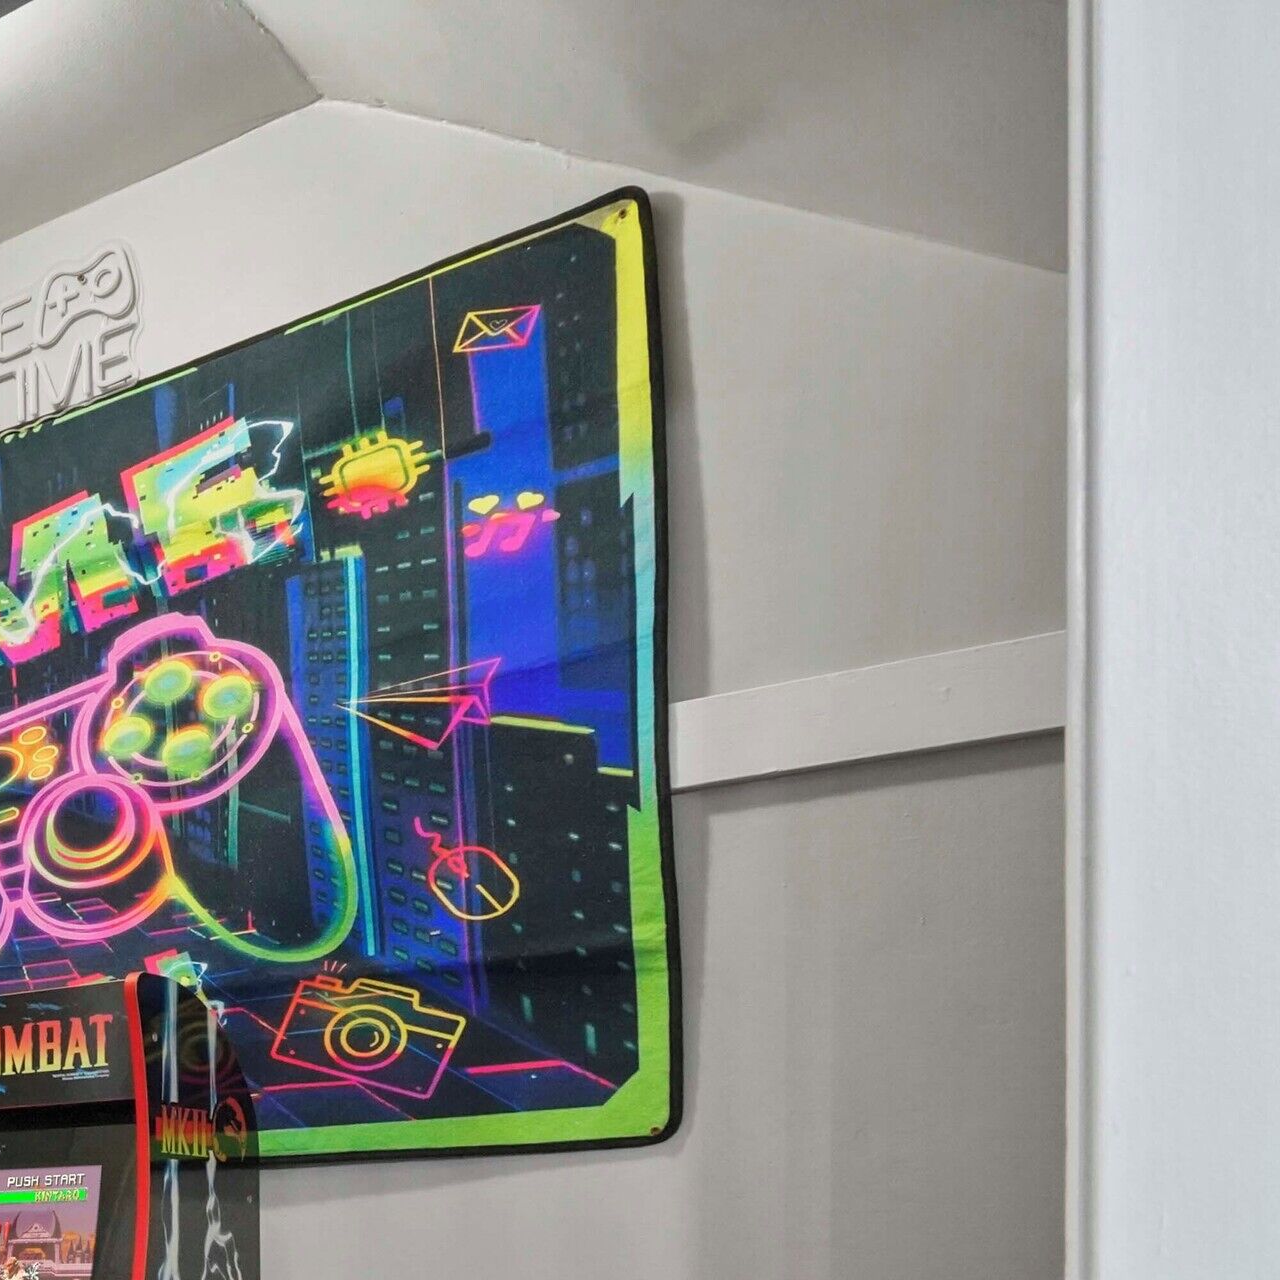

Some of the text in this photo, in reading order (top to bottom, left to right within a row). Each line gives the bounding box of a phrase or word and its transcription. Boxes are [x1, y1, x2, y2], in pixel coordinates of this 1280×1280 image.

[162, 1103, 211, 1160] MKII
[7, 1173, 85, 1187] PUSH START
[34, 1190, 80, 1202] KINTARO
